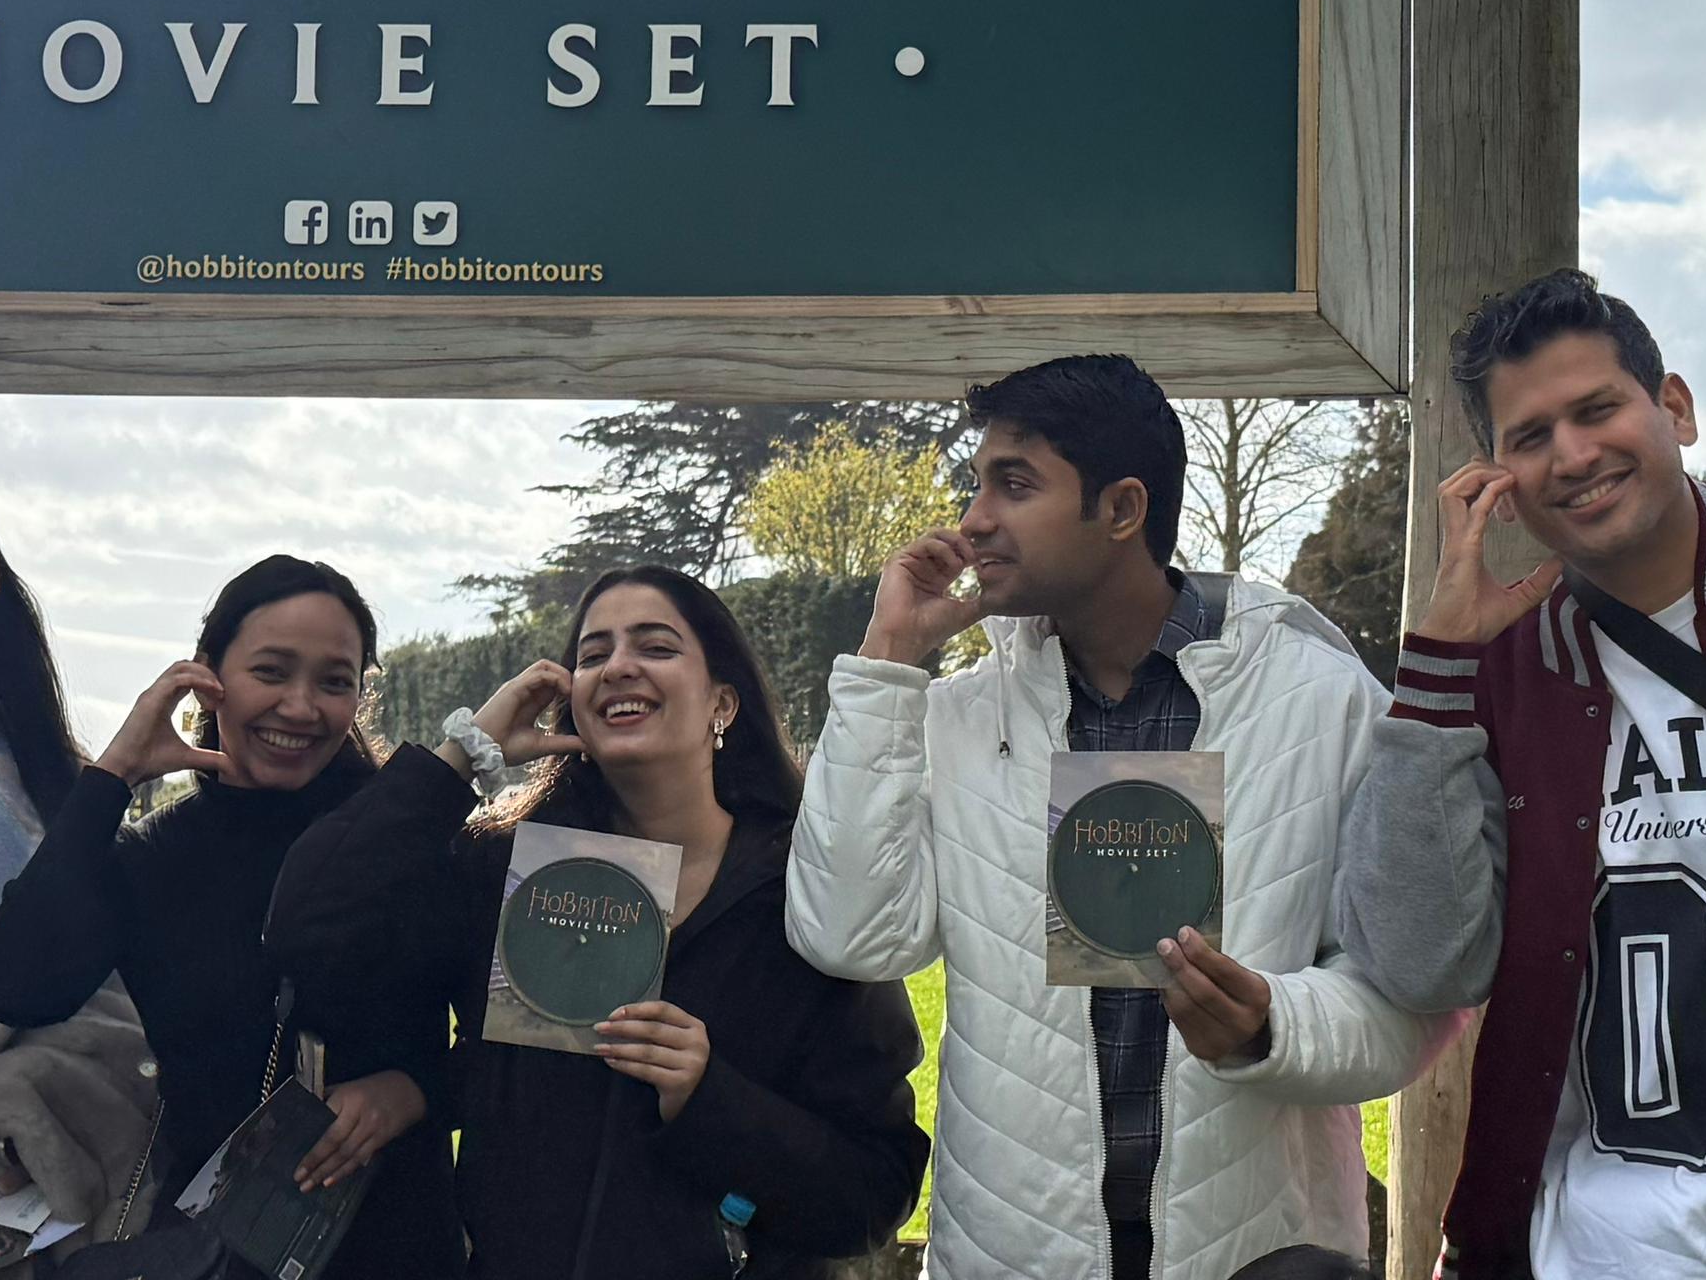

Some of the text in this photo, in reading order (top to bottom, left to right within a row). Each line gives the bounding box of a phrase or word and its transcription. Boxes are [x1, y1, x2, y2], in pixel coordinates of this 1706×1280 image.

[545, 22, 823, 107] SET
[137, 253, 604, 284] @hobbitontours #hobbitontours
[1073, 818, 1188, 854] HOBBITON
[1096, 848, 1169, 858] MOVIE SET
[528, 886, 642, 925] HOBBITON
[548, 916, 618, 935] MOVIE SET
